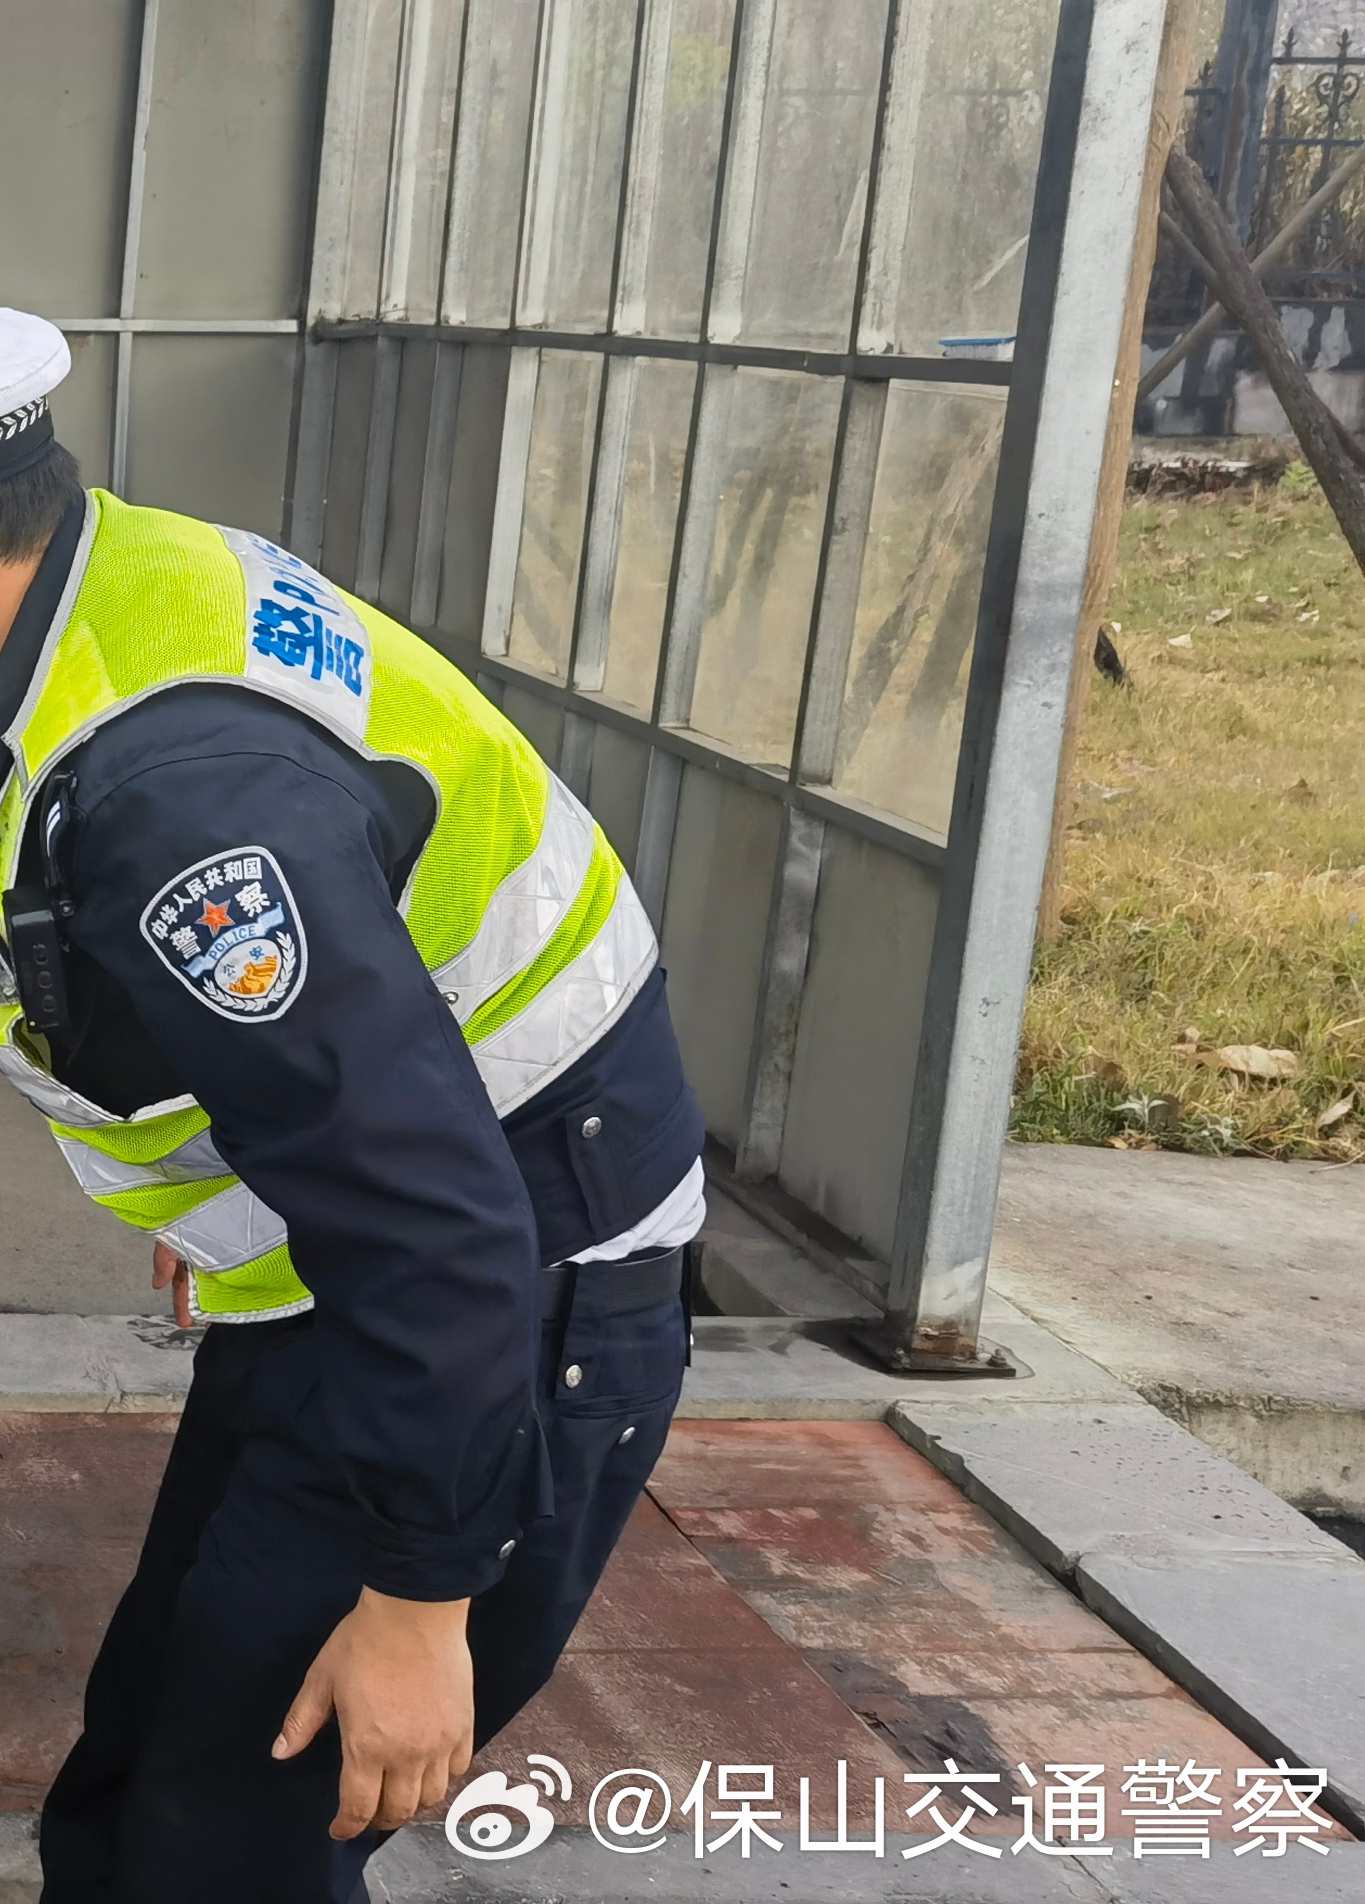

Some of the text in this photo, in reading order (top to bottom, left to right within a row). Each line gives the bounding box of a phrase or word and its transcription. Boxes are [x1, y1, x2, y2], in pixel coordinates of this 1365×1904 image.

[252, 598, 365, 698] 警
[151, 856, 263, 940] 中华人民共和国
[169, 881, 271, 960] 警 察
[208, 925, 257, 961] POLICE
